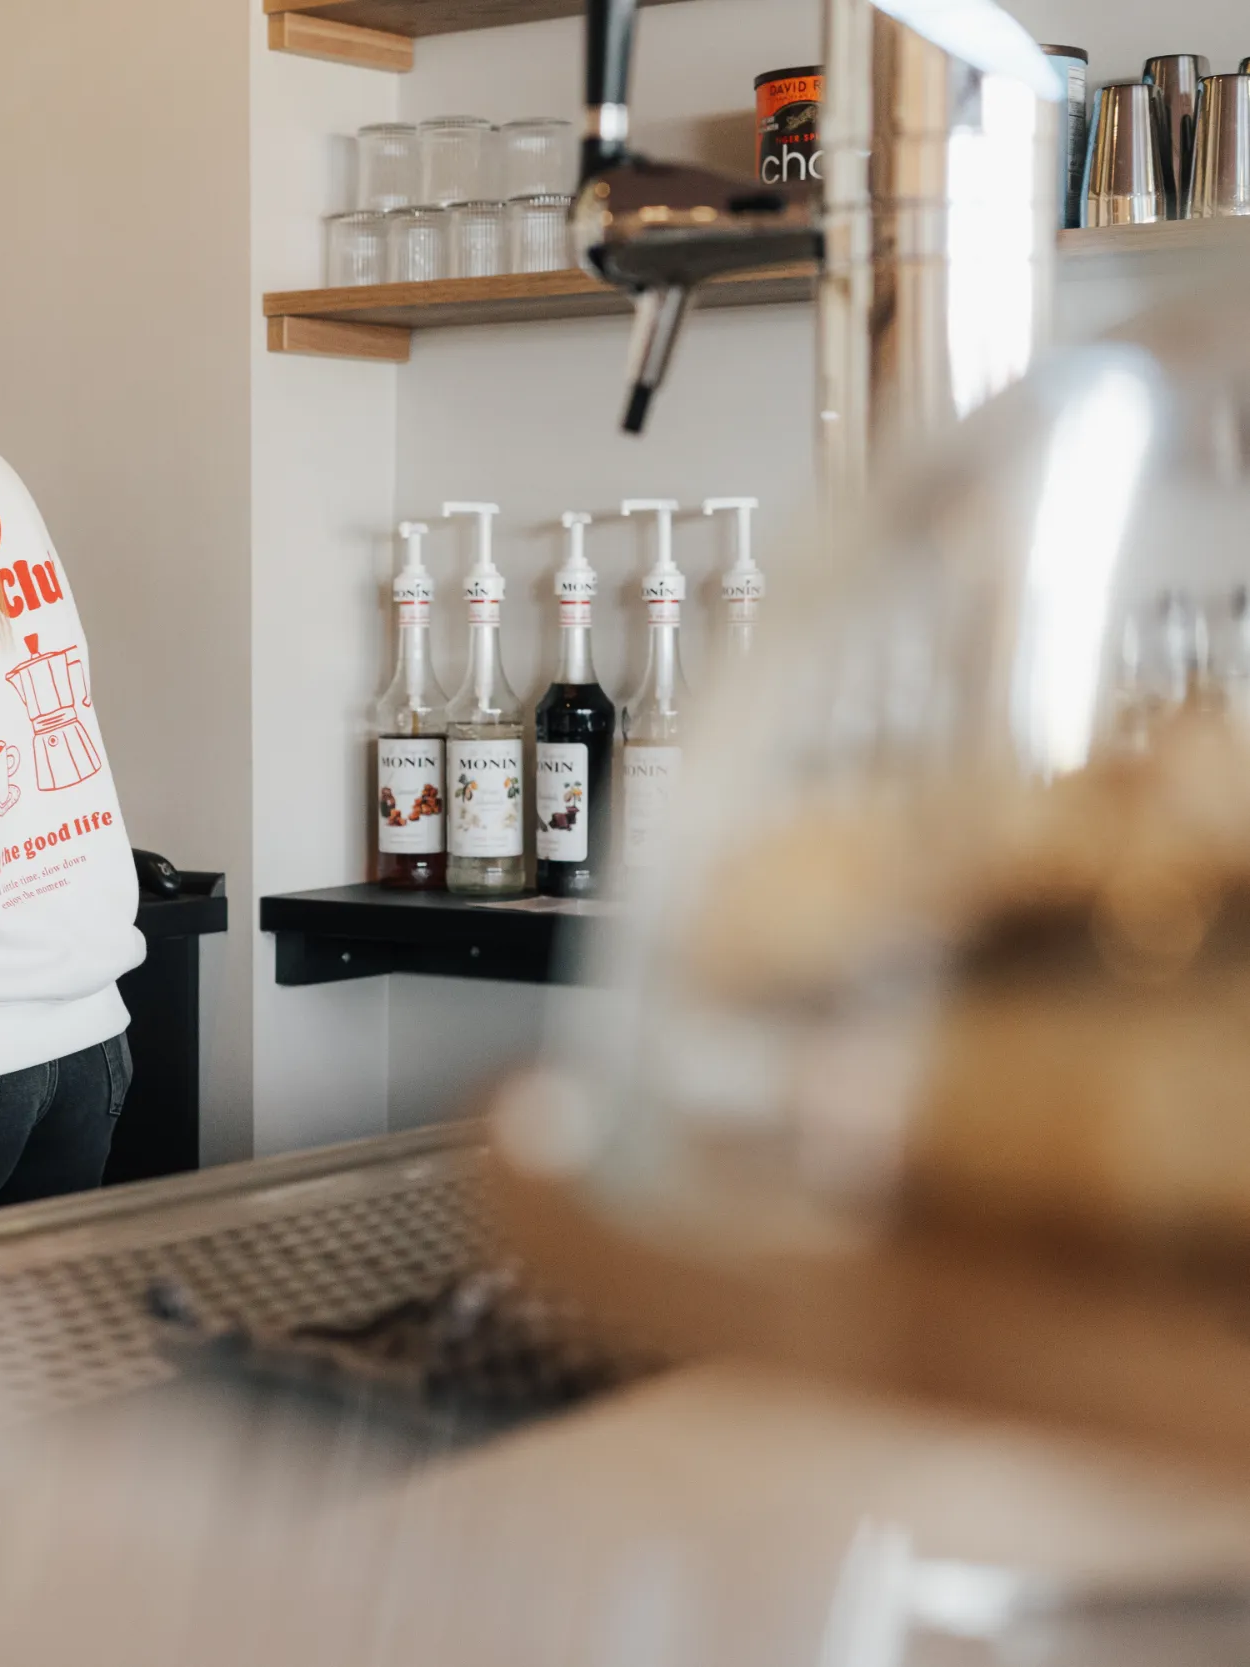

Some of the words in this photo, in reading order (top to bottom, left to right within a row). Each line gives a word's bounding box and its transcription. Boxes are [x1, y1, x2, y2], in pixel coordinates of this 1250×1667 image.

[769, 81, 807, 97] DAVID
[380, 756, 437, 769] MONIN
[458, 758, 518, 770] MONIN
[23, 822, 72, 861] good
[73, 810, 114, 836] life
[41, 864, 61, 878] slow
[62, 854, 87, 870] down
